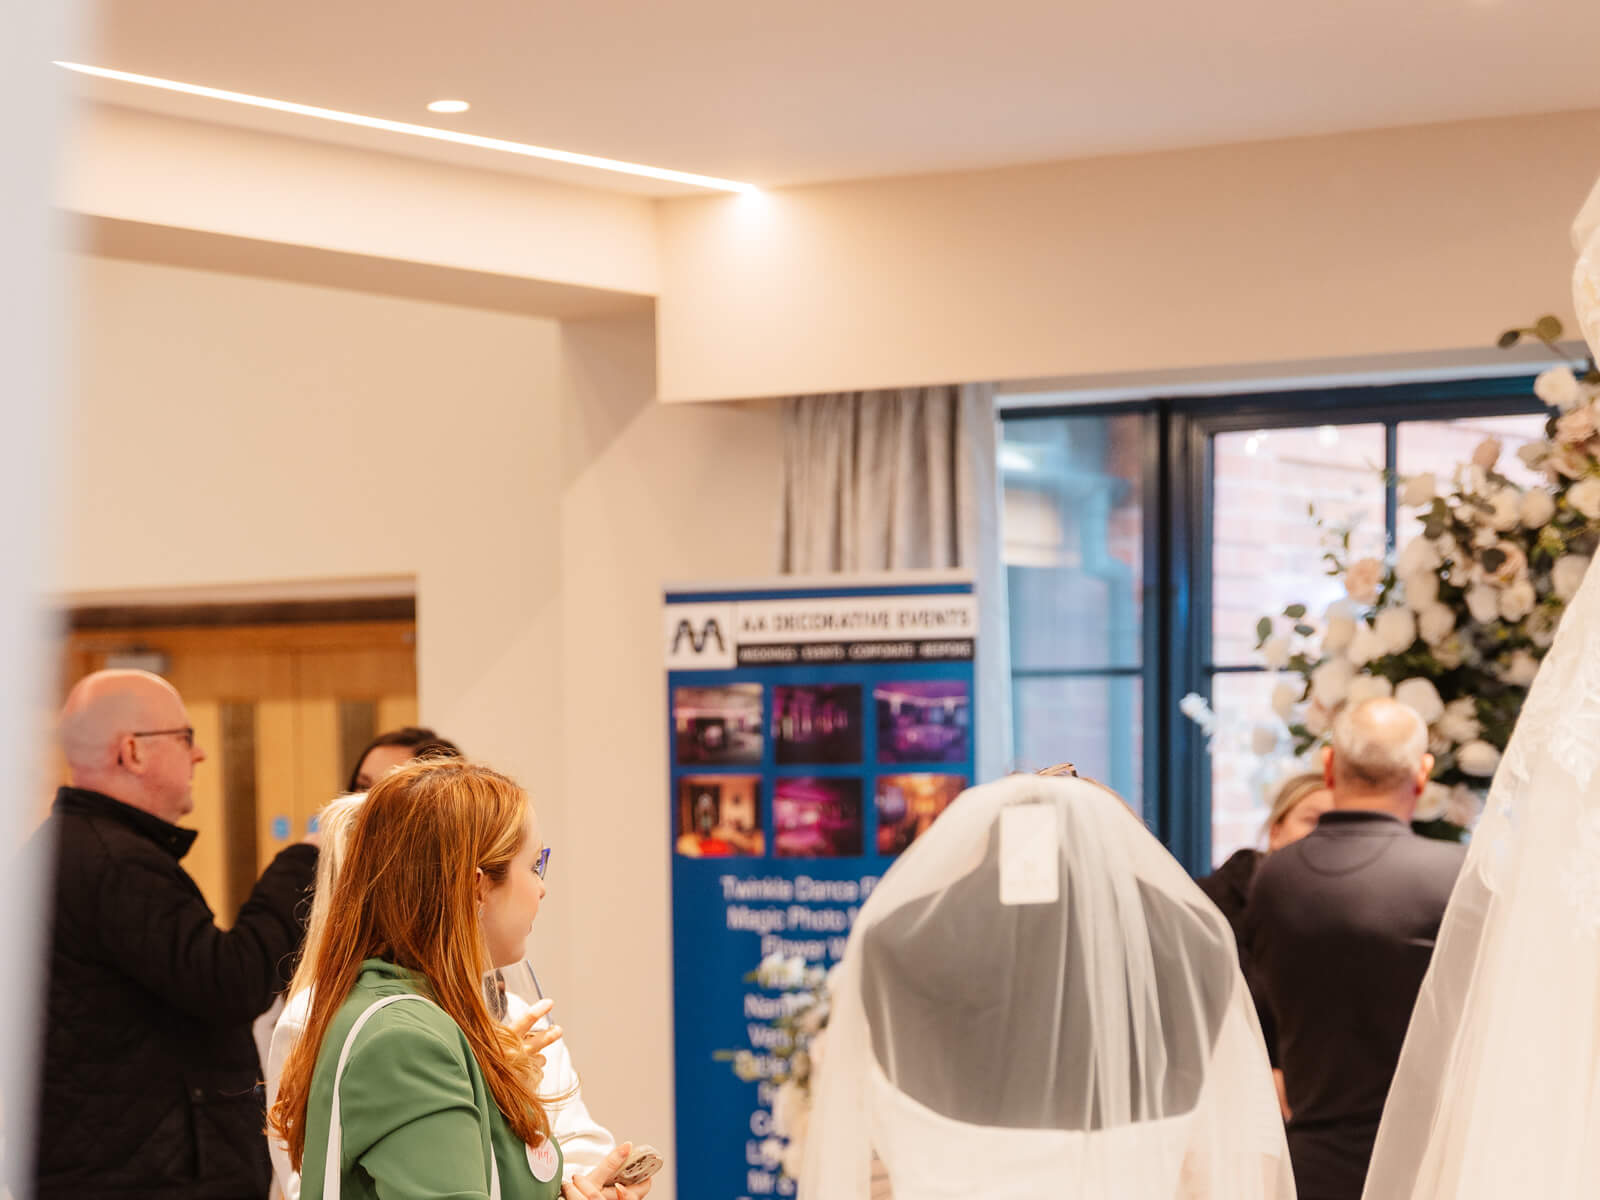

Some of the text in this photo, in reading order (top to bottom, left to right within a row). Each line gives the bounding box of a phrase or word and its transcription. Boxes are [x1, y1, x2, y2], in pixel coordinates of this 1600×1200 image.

[773, 608, 890, 633] DECORATIVE
[898, 605, 969, 630] EVENTS
[720, 875, 794, 902] Twinkle
[795, 876, 859, 902] Dance
[726, 905, 786, 935] Magic
[787, 905, 847, 931] Photo
